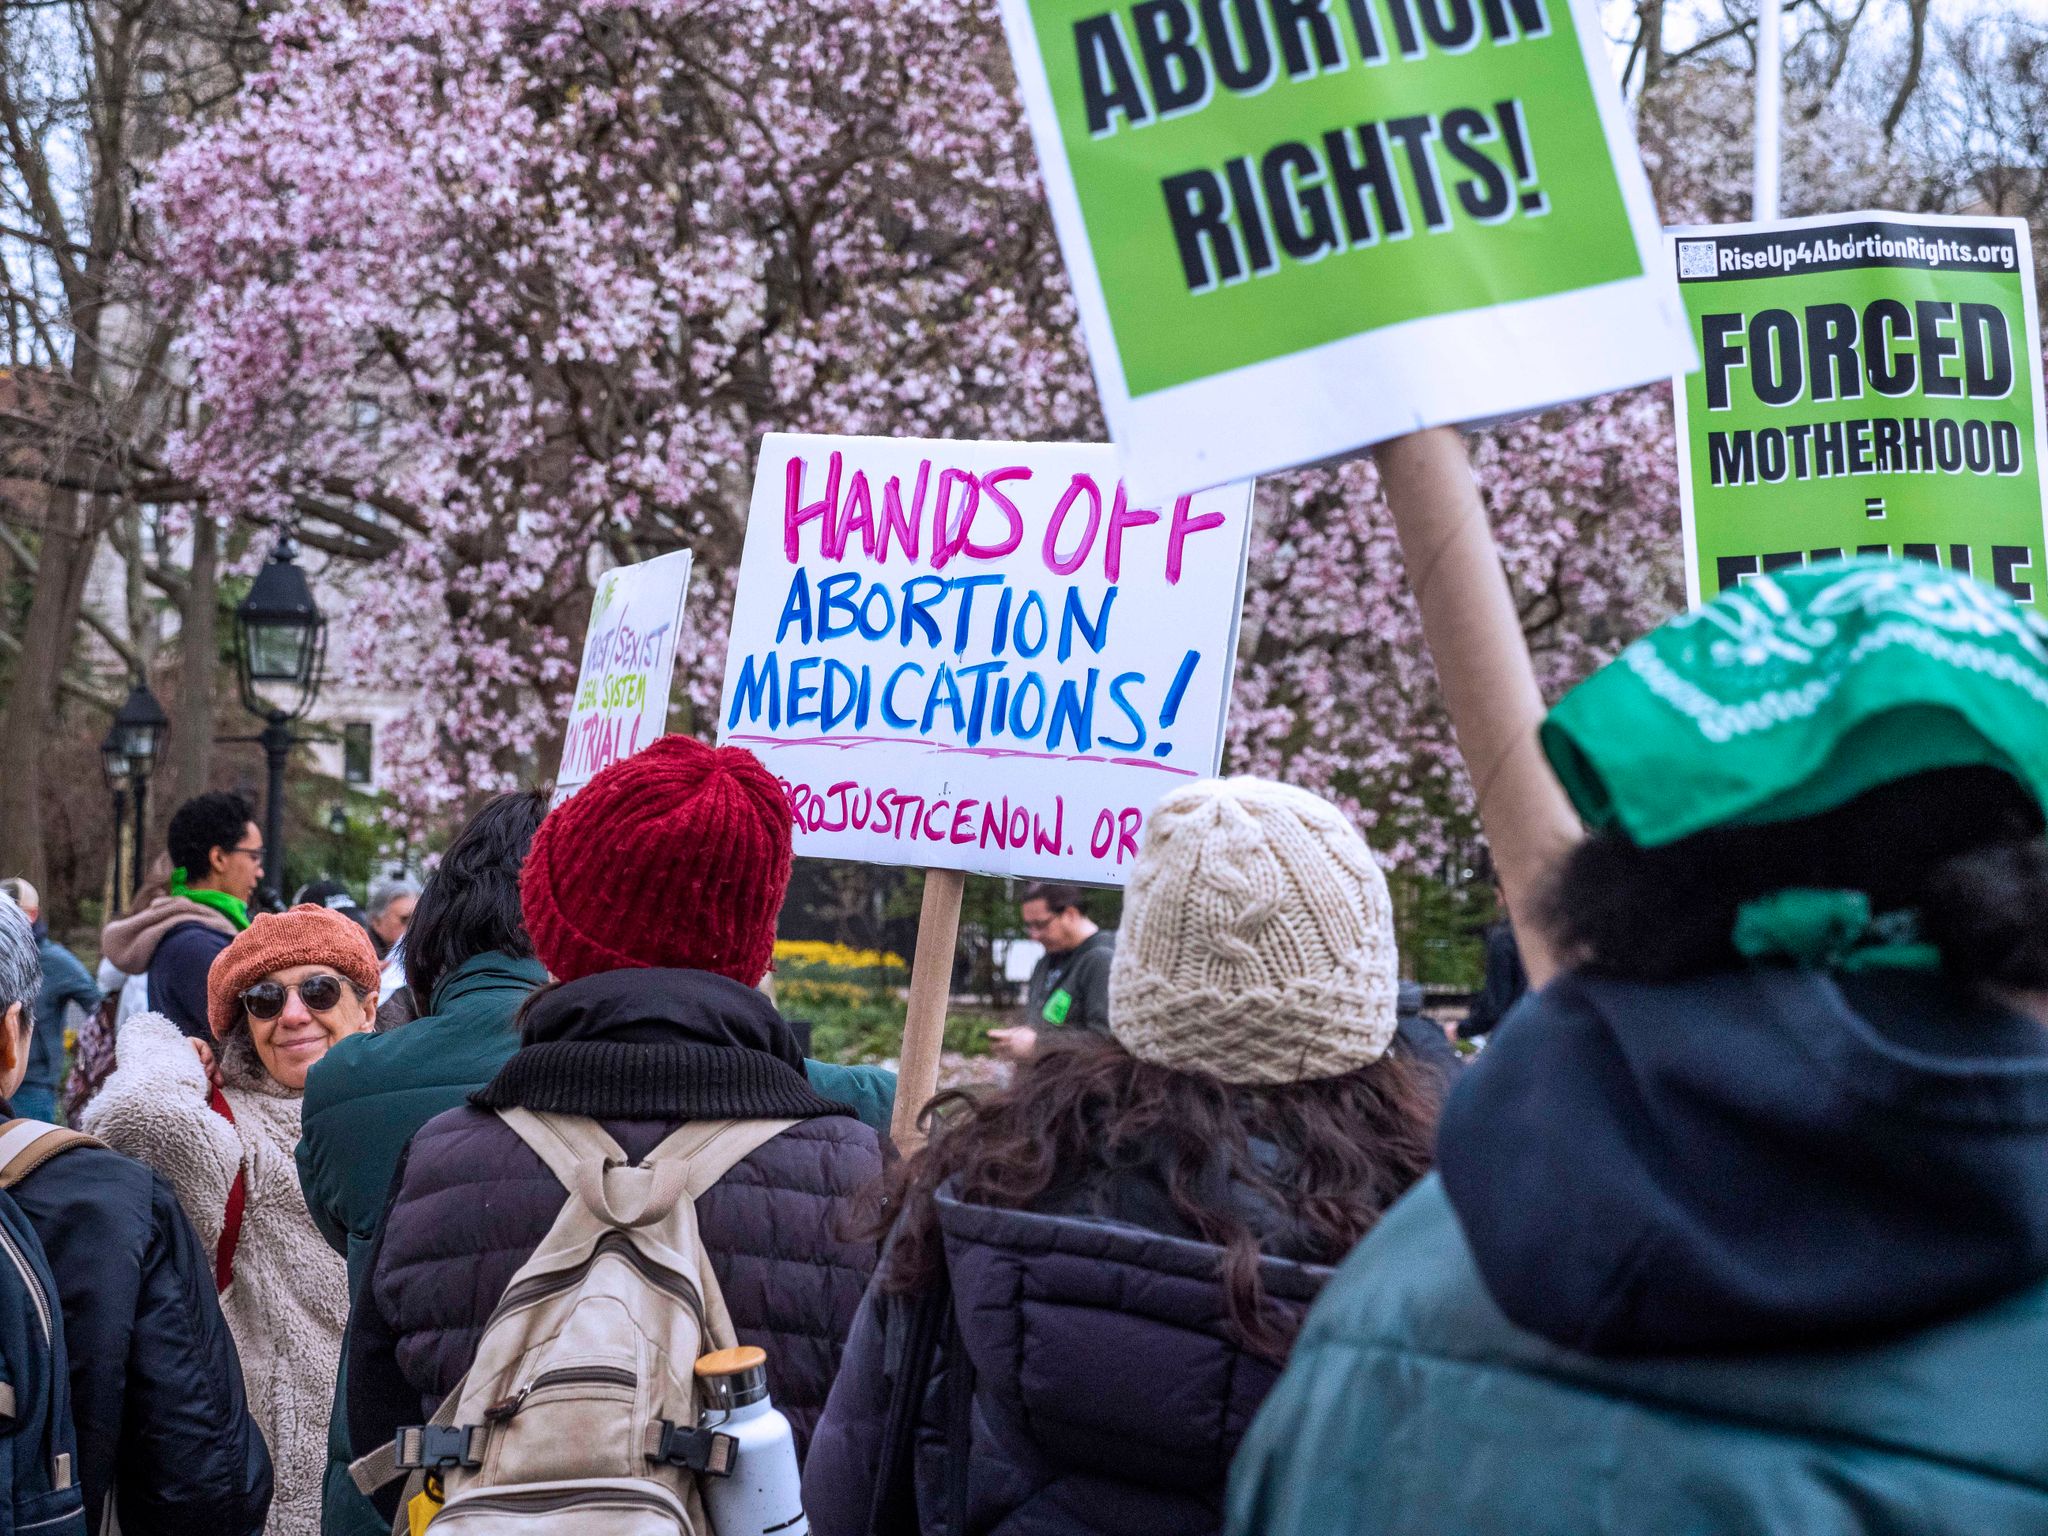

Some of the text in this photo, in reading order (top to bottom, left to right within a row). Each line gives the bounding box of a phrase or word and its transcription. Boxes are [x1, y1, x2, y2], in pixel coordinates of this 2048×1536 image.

[1160, 99, 1550, 295] RIGHTS!
[1719, 234, 2014, 271] RiseUp4AbortionRights.org
[1701, 298, 2015, 411] FORCED
[1708, 417, 2022, 487] MOTHERHOOD
[784, 451, 1033, 569] HANDS
[776, 566, 1119, 663] ABORTION
[602, 673, 647, 720] SYSTEM
[727, 649, 1201, 756] MEDICATIONS!
